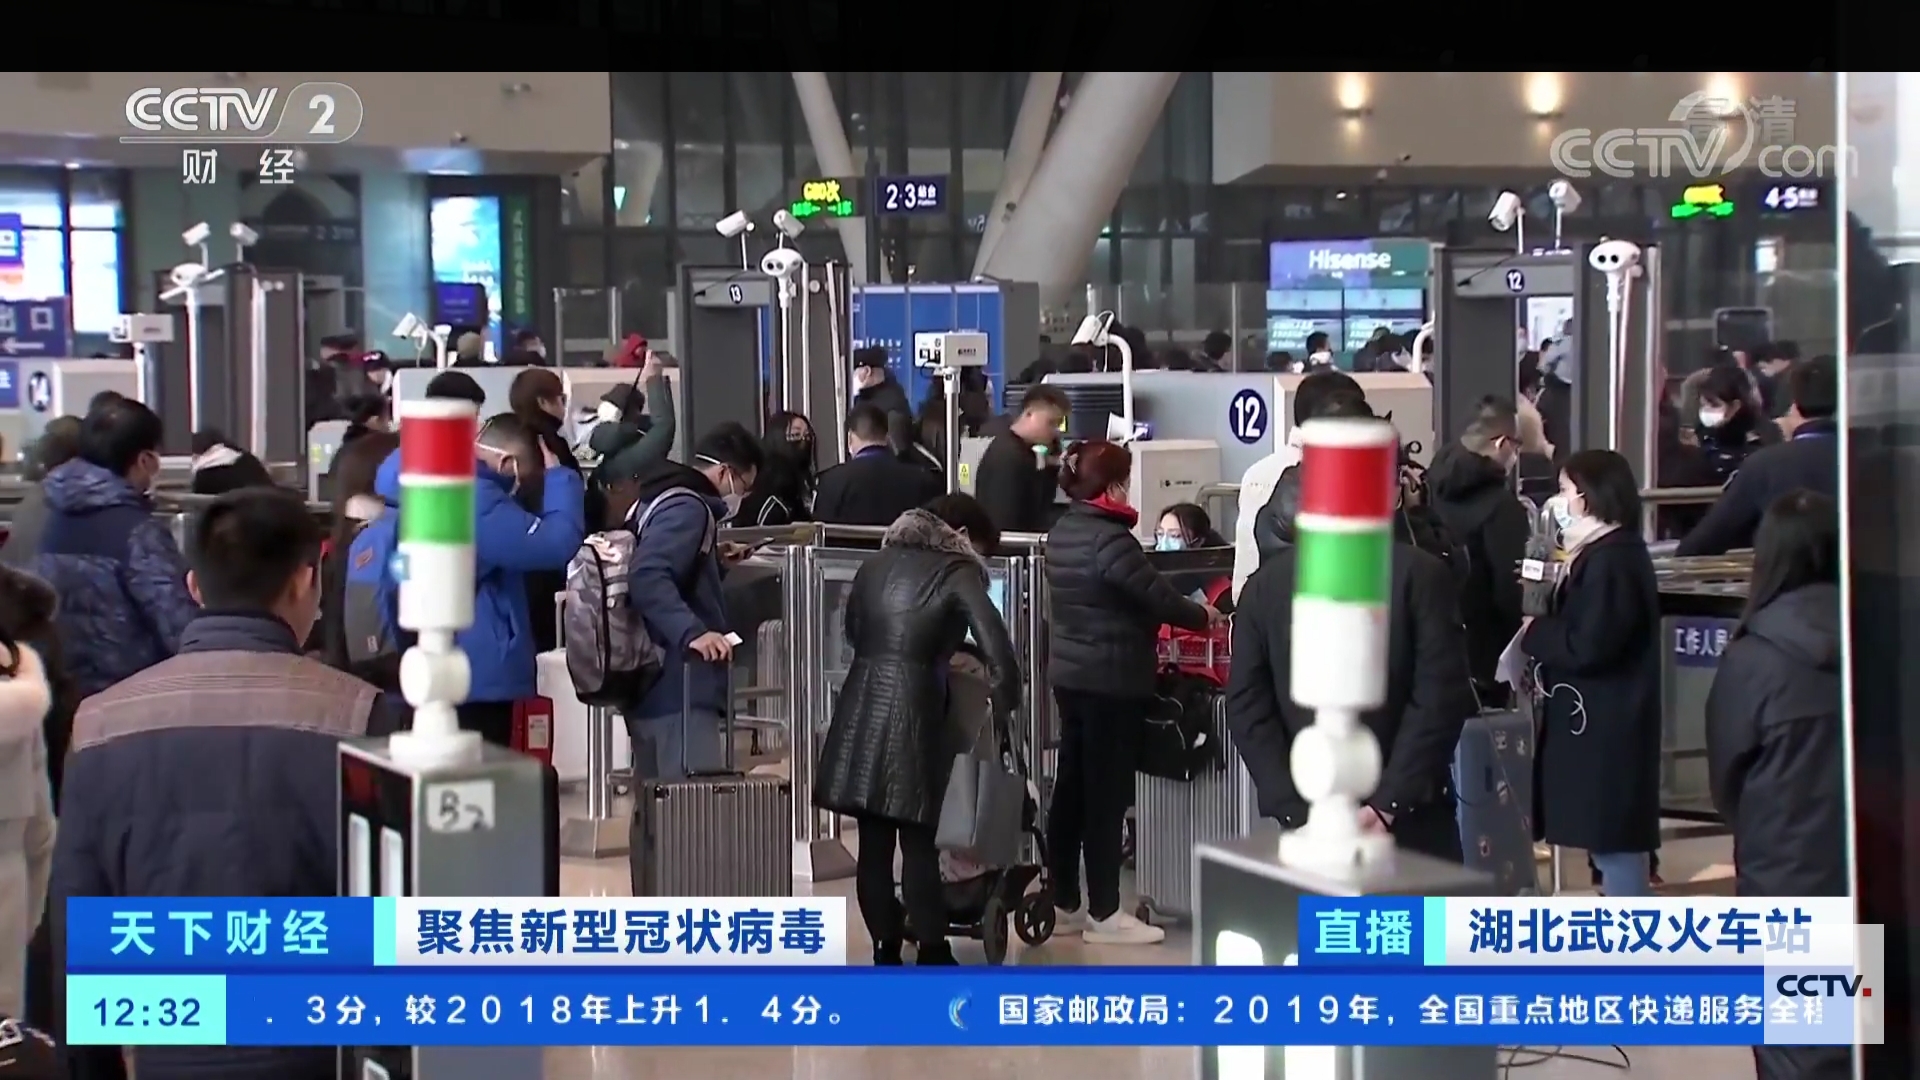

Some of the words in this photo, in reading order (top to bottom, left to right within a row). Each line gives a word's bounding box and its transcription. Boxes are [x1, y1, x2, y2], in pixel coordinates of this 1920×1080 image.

[1308, 249, 1391, 270] Hisense
[1507, 271, 1523, 290] 12
[730, 285, 741, 302] 13
[1235, 396, 1260, 438] 12
[1675, 627, 1733, 657] 工作人员
